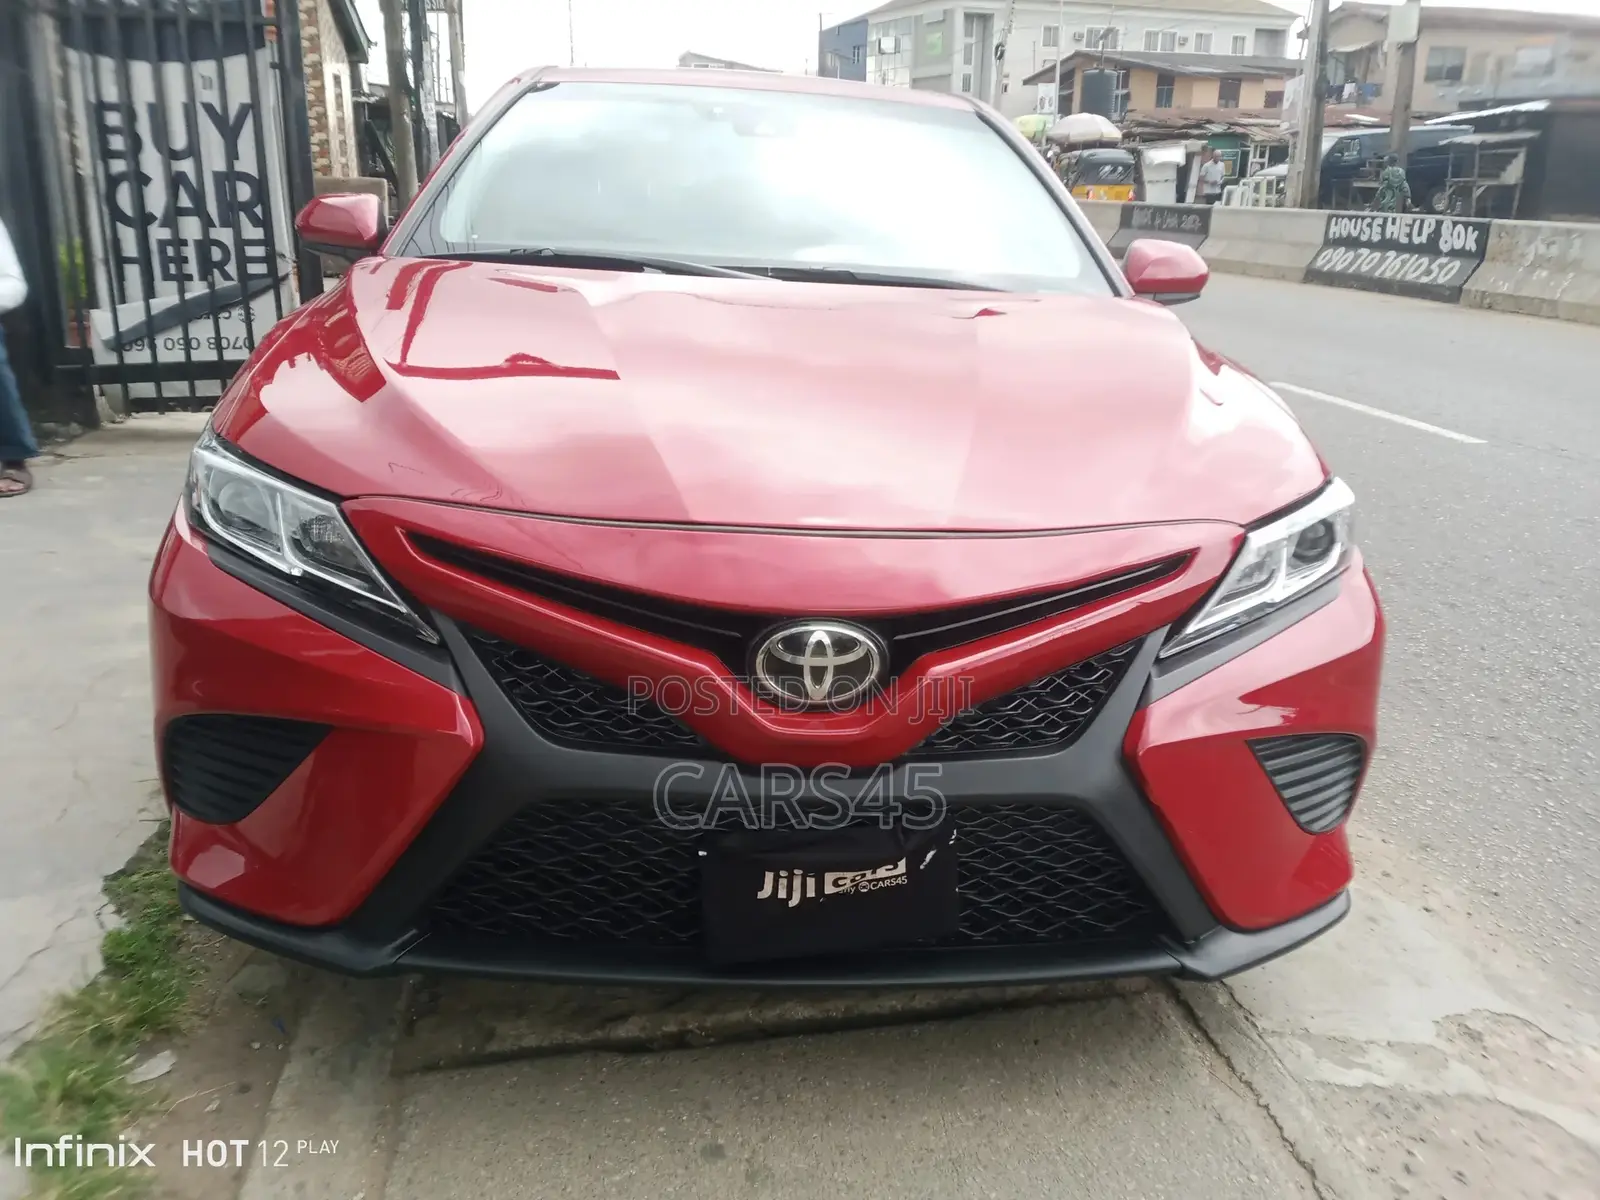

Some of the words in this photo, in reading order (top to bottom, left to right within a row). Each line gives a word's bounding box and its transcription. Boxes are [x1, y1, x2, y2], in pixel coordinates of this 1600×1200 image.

[97, 101, 252, 160] BUY
[106, 170, 264, 229] CAR
[1328, 216, 1384, 243] HOUSE
[1385, 216, 1436, 245] HELP
[1438, 218, 1479, 253] 80K
[117, 237, 272, 282] HERE
[870, 875, 908, 890] CARS45
